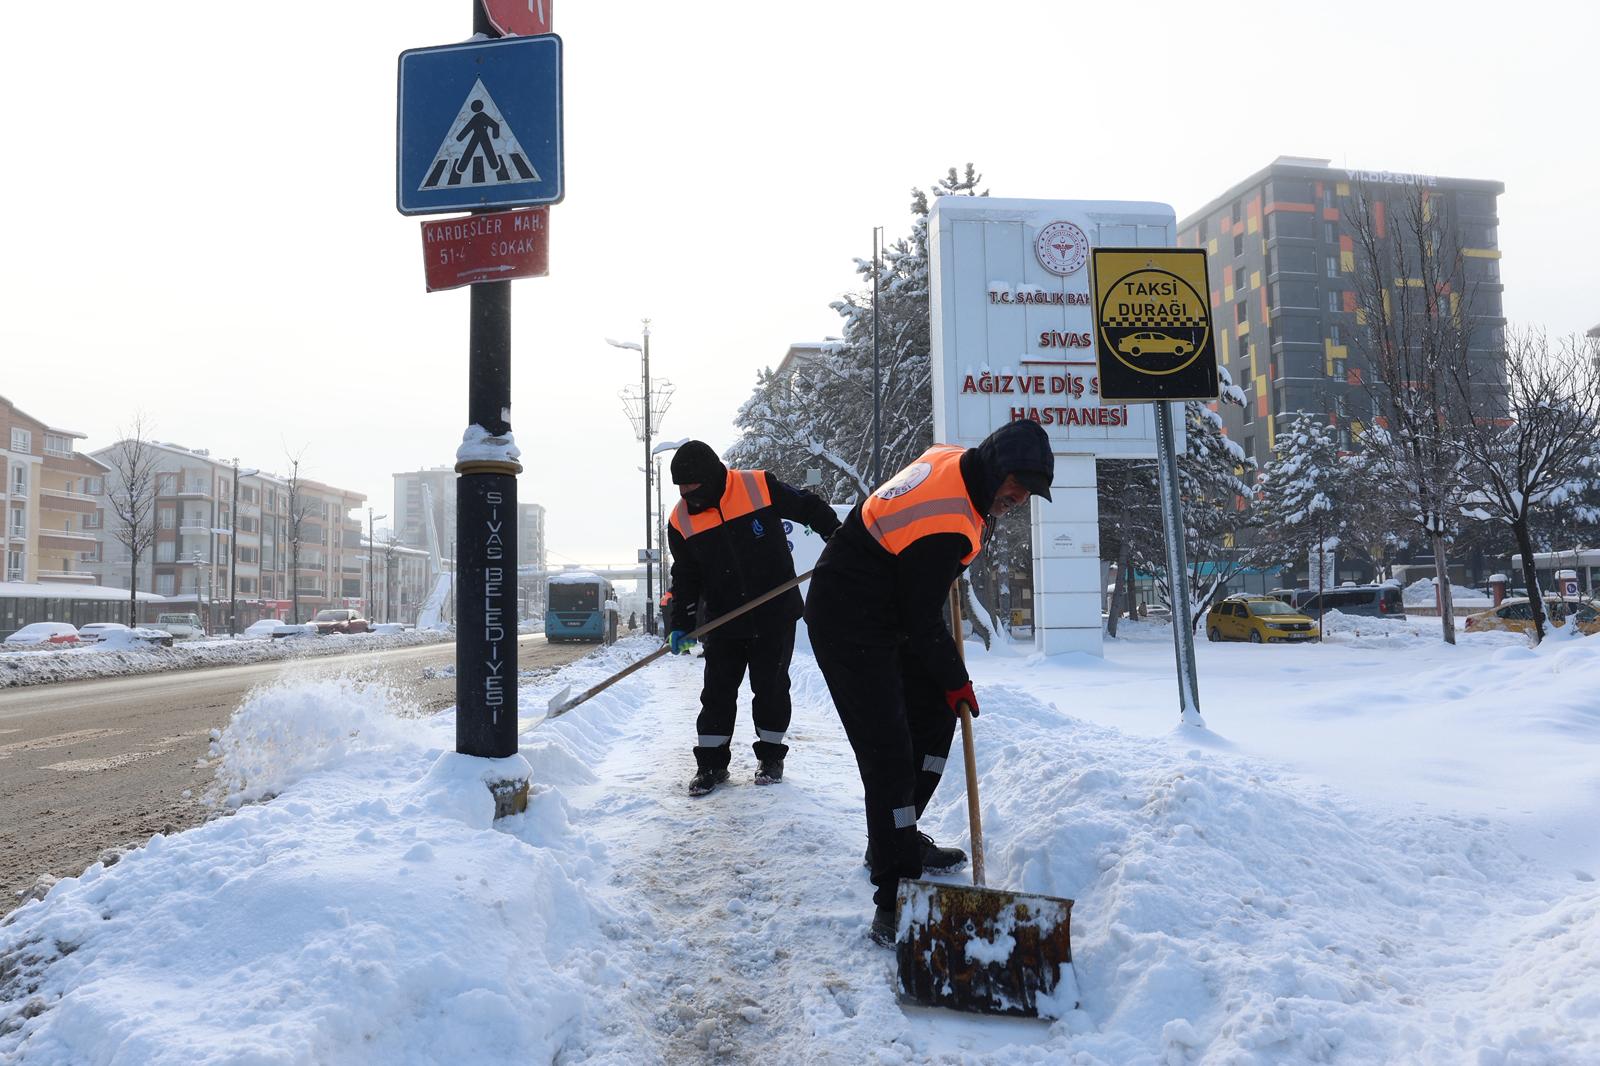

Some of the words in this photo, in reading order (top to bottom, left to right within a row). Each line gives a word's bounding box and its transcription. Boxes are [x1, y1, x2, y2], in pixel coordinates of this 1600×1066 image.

[514, 214, 544, 232] MAH.
[490, 238, 534, 257] SOKAK
[1016, 289, 1065, 304] SAĞLIK
[1124, 279, 1178, 296] TAKSİ
[1118, 299, 1187, 316] DURAĞI
[1040, 329, 1091, 348] SİVAS
[963, 371, 1015, 394] AĞIZ
[1017, 375, 1045, 394] VE
[1051, 372, 1085, 399] DİŞ
[1010, 405, 1128, 426] HASTANESİ
[486, 491, 503, 560] SİVAS
[485, 567, 504, 725] BELEDİYESİ
